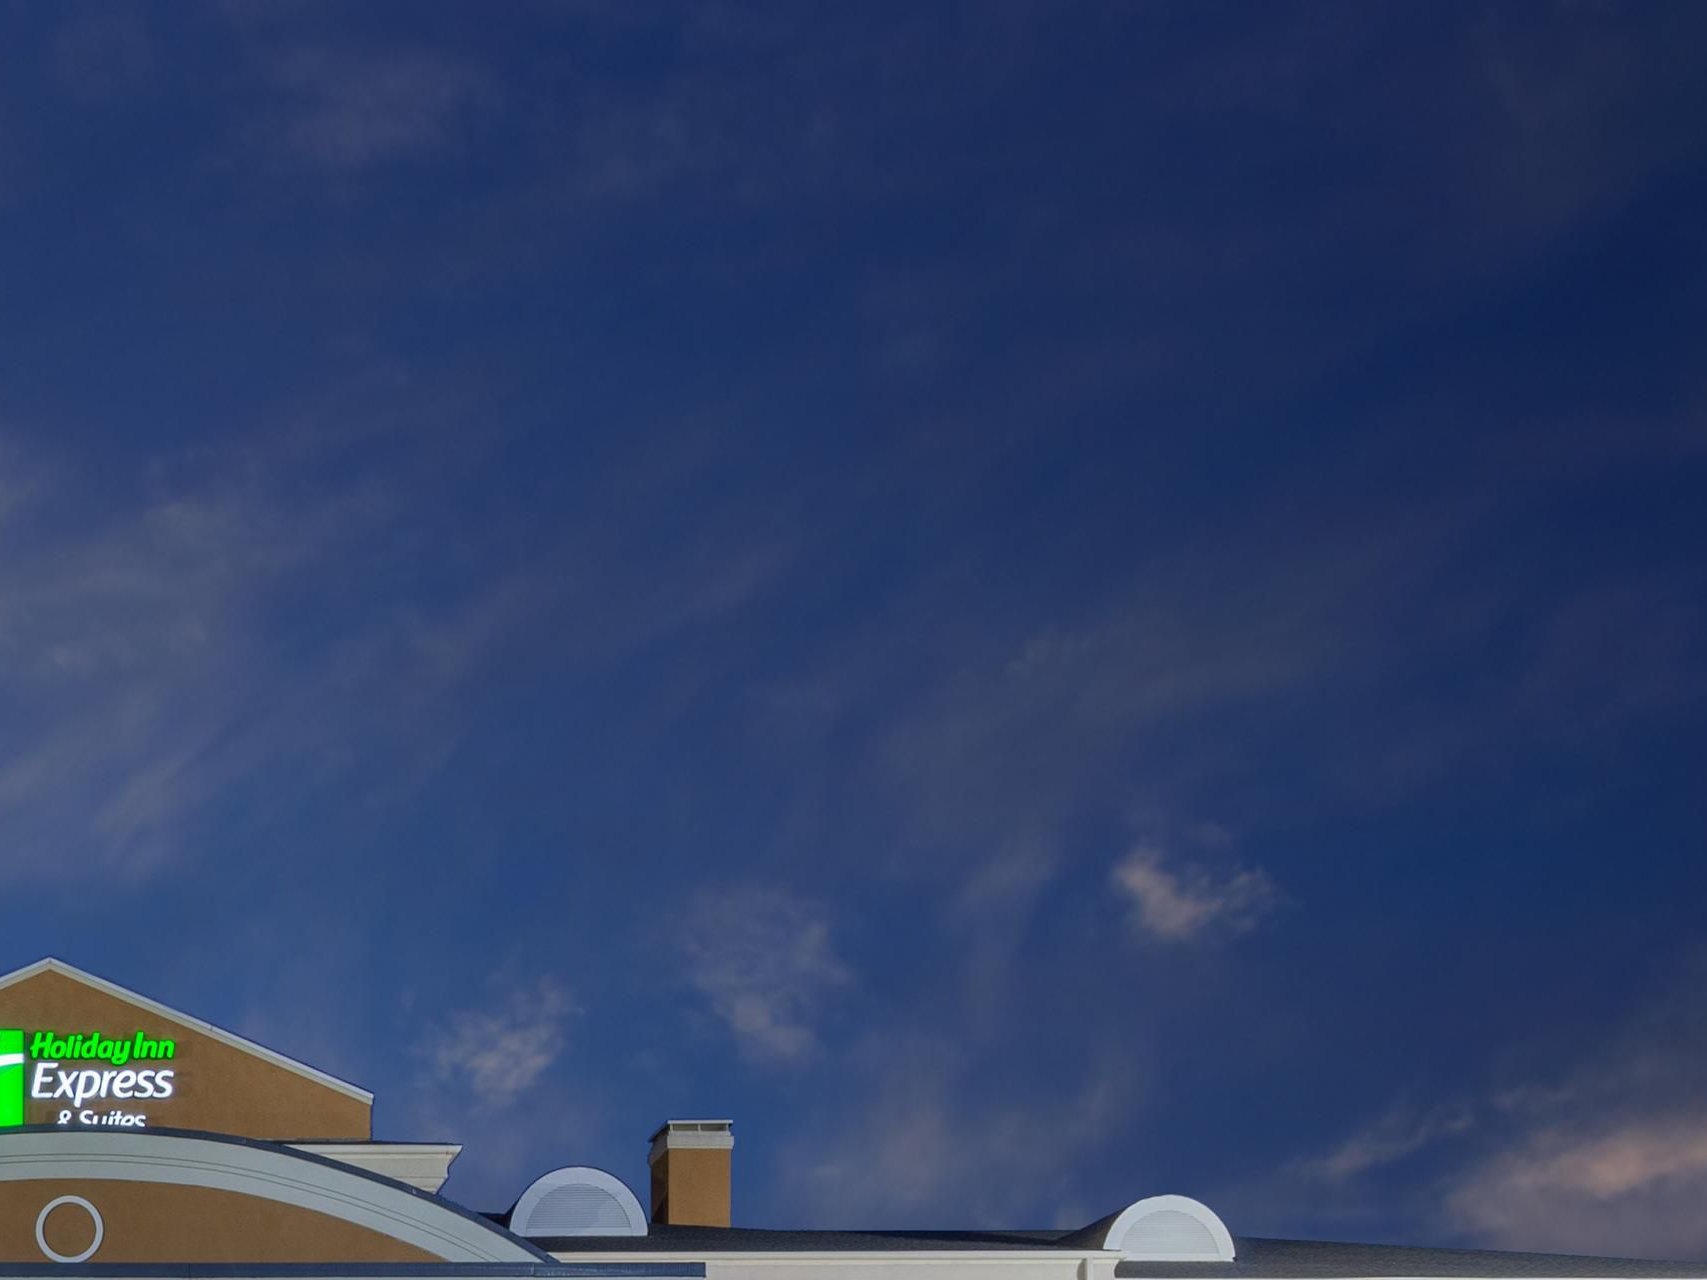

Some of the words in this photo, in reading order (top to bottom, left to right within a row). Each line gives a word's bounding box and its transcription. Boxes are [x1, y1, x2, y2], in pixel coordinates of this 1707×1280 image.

[30, 1031, 131, 1064] Holiday
[133, 1031, 175, 1059] Inn
[31, 1062, 175, 1108] Express
